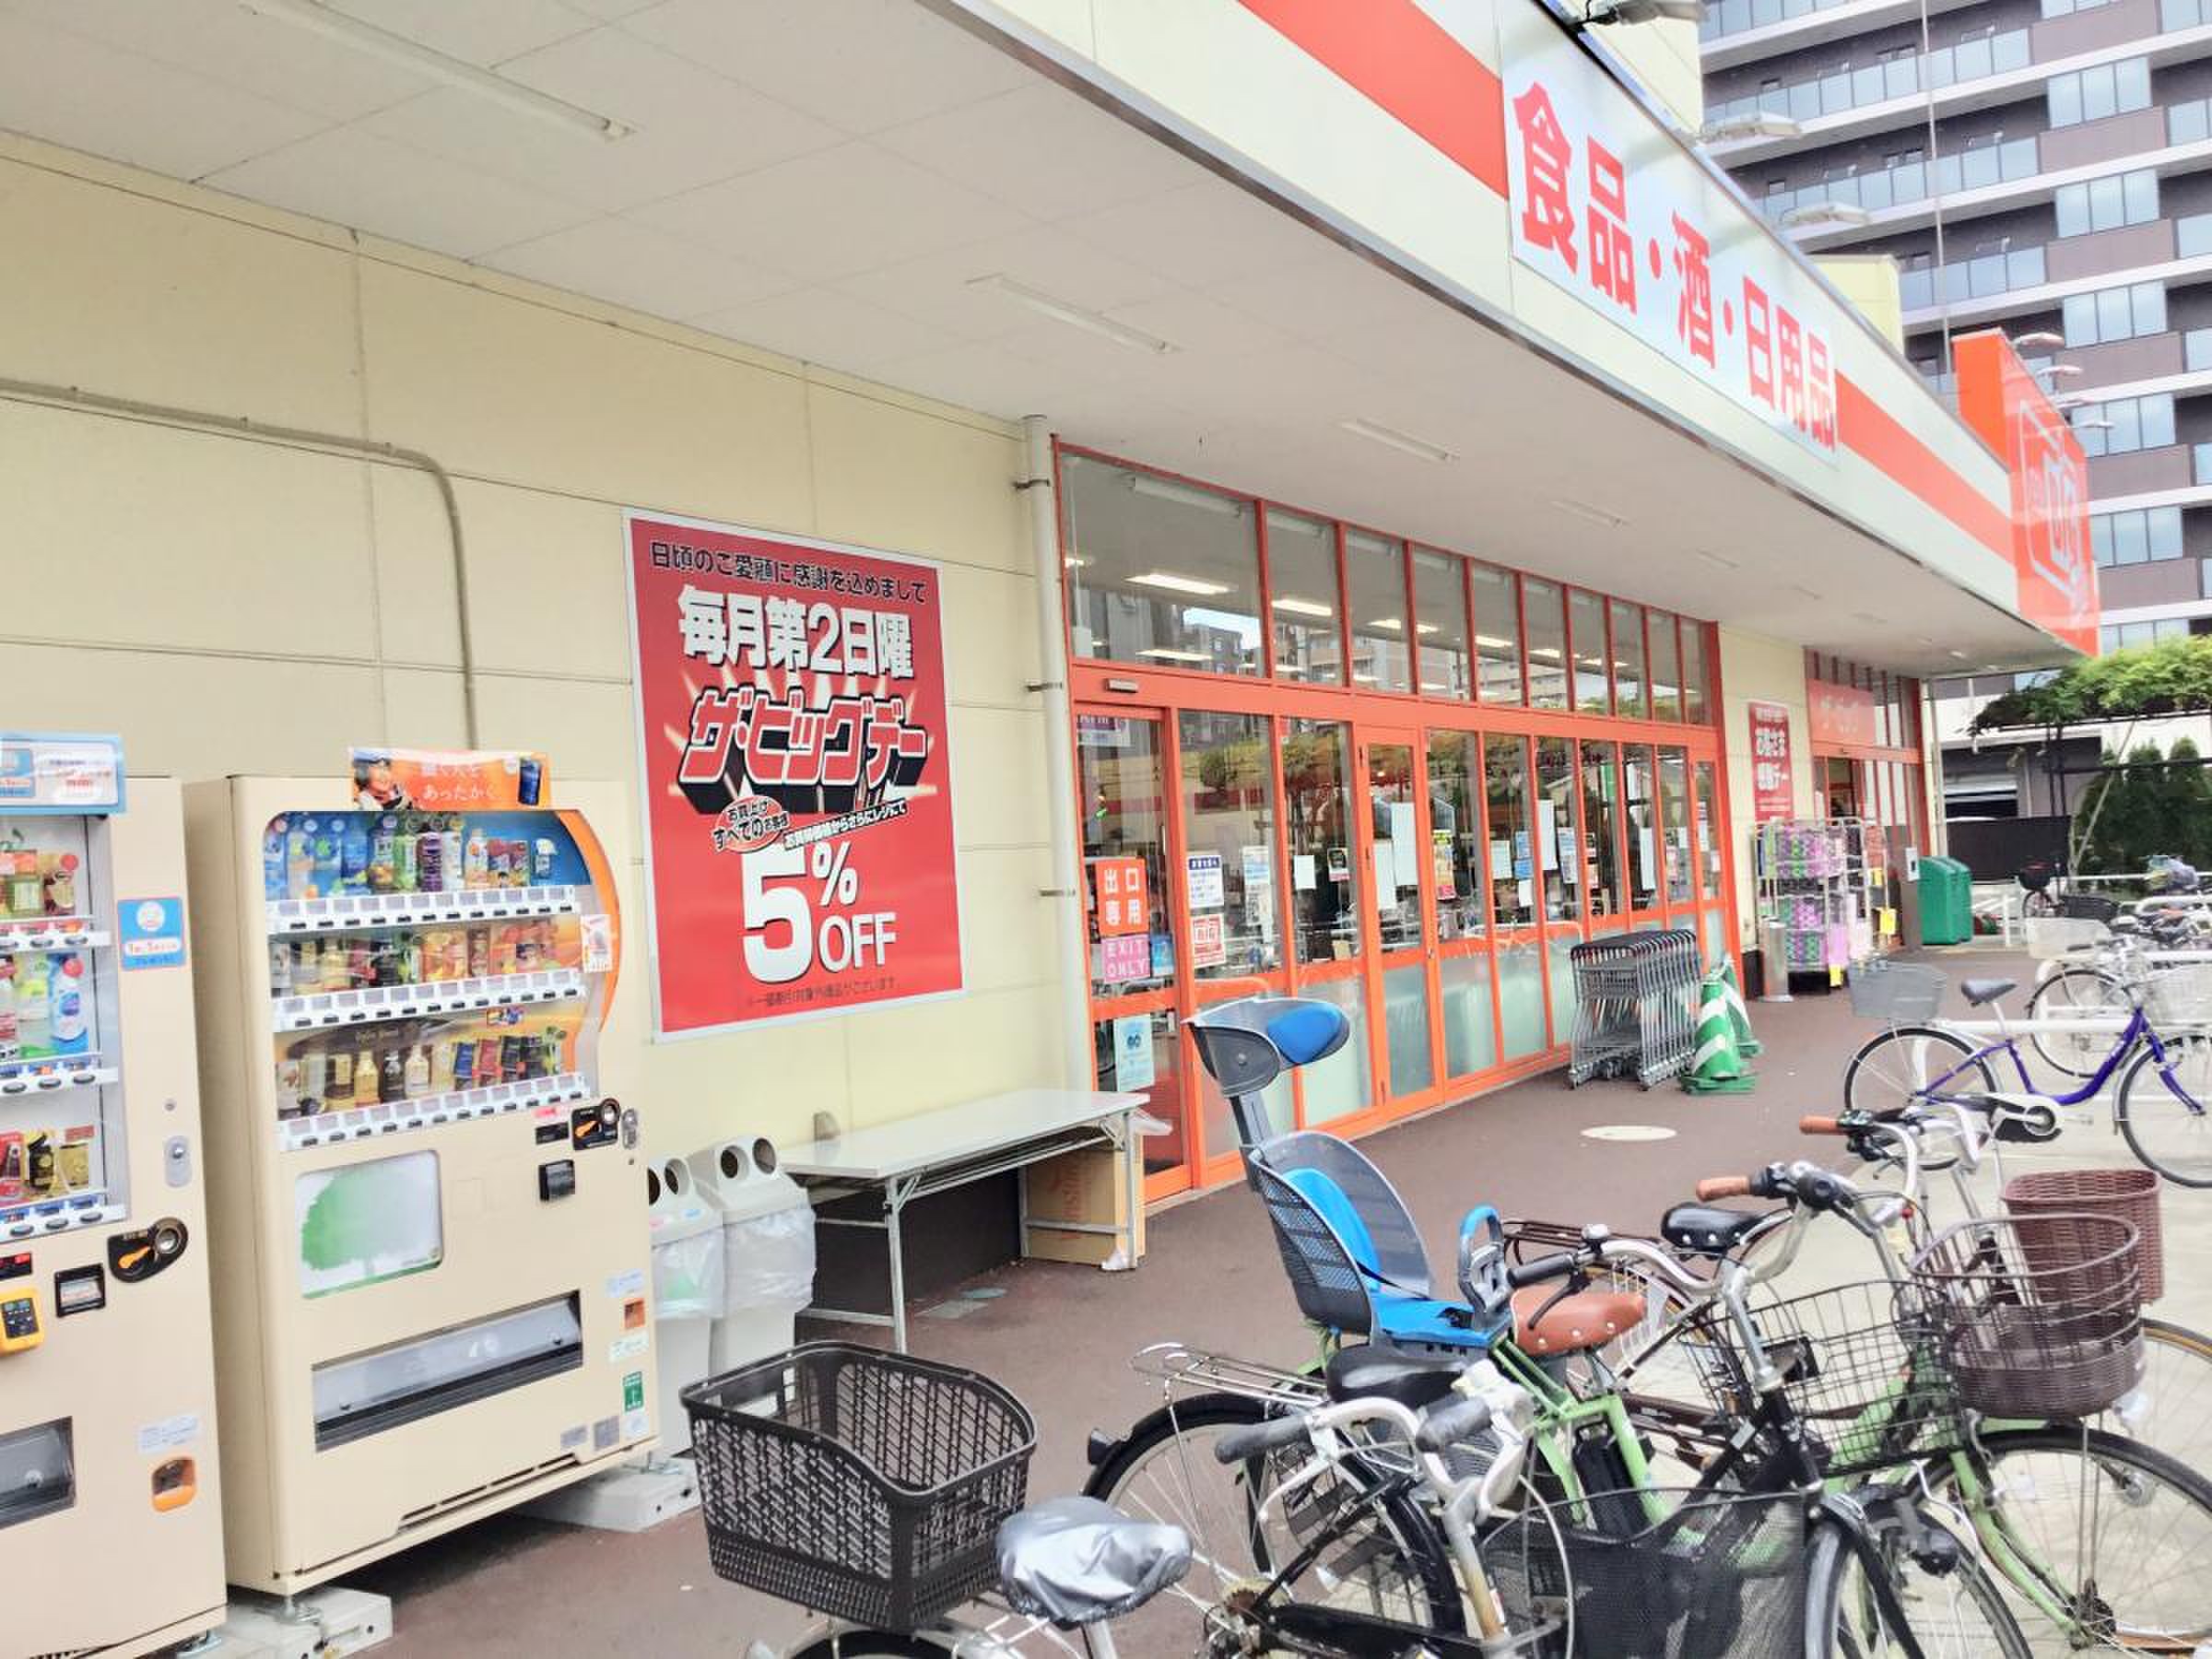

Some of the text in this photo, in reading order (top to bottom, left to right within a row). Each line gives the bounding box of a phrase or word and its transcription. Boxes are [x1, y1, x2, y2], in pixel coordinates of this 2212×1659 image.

[1513, 81, 1835, 452] 食品・酒・日用品
[678, 584, 914, 679] 毎月第2日曜
[818, 912, 897, 972] OFF
[1107, 939, 1143, 959] EXIT
[1107, 959, 1147, 978] ONLY
